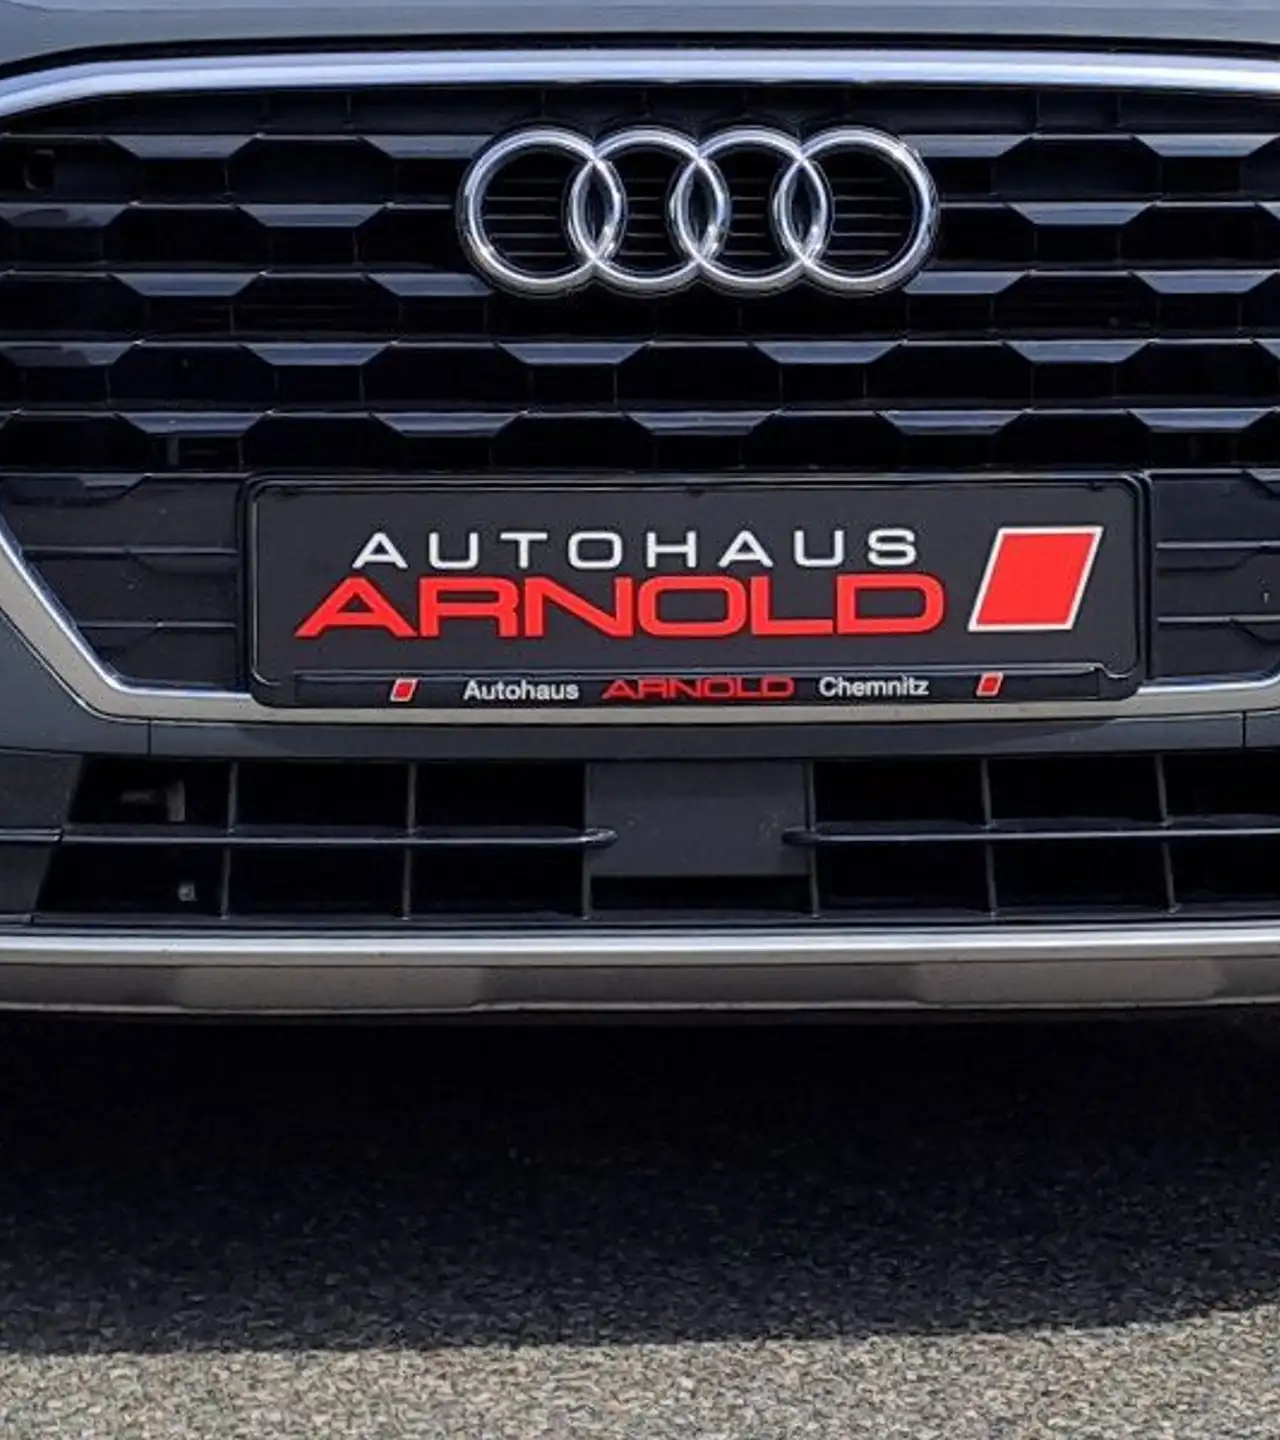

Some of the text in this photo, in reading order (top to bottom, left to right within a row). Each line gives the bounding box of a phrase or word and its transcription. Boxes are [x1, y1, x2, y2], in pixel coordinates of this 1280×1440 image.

[351, 529, 918, 569] AUTOHAUS
[293, 575, 945, 638] ARNOLD
[463, 675, 930, 701] Autohaus ARNOLD Chemnitz
